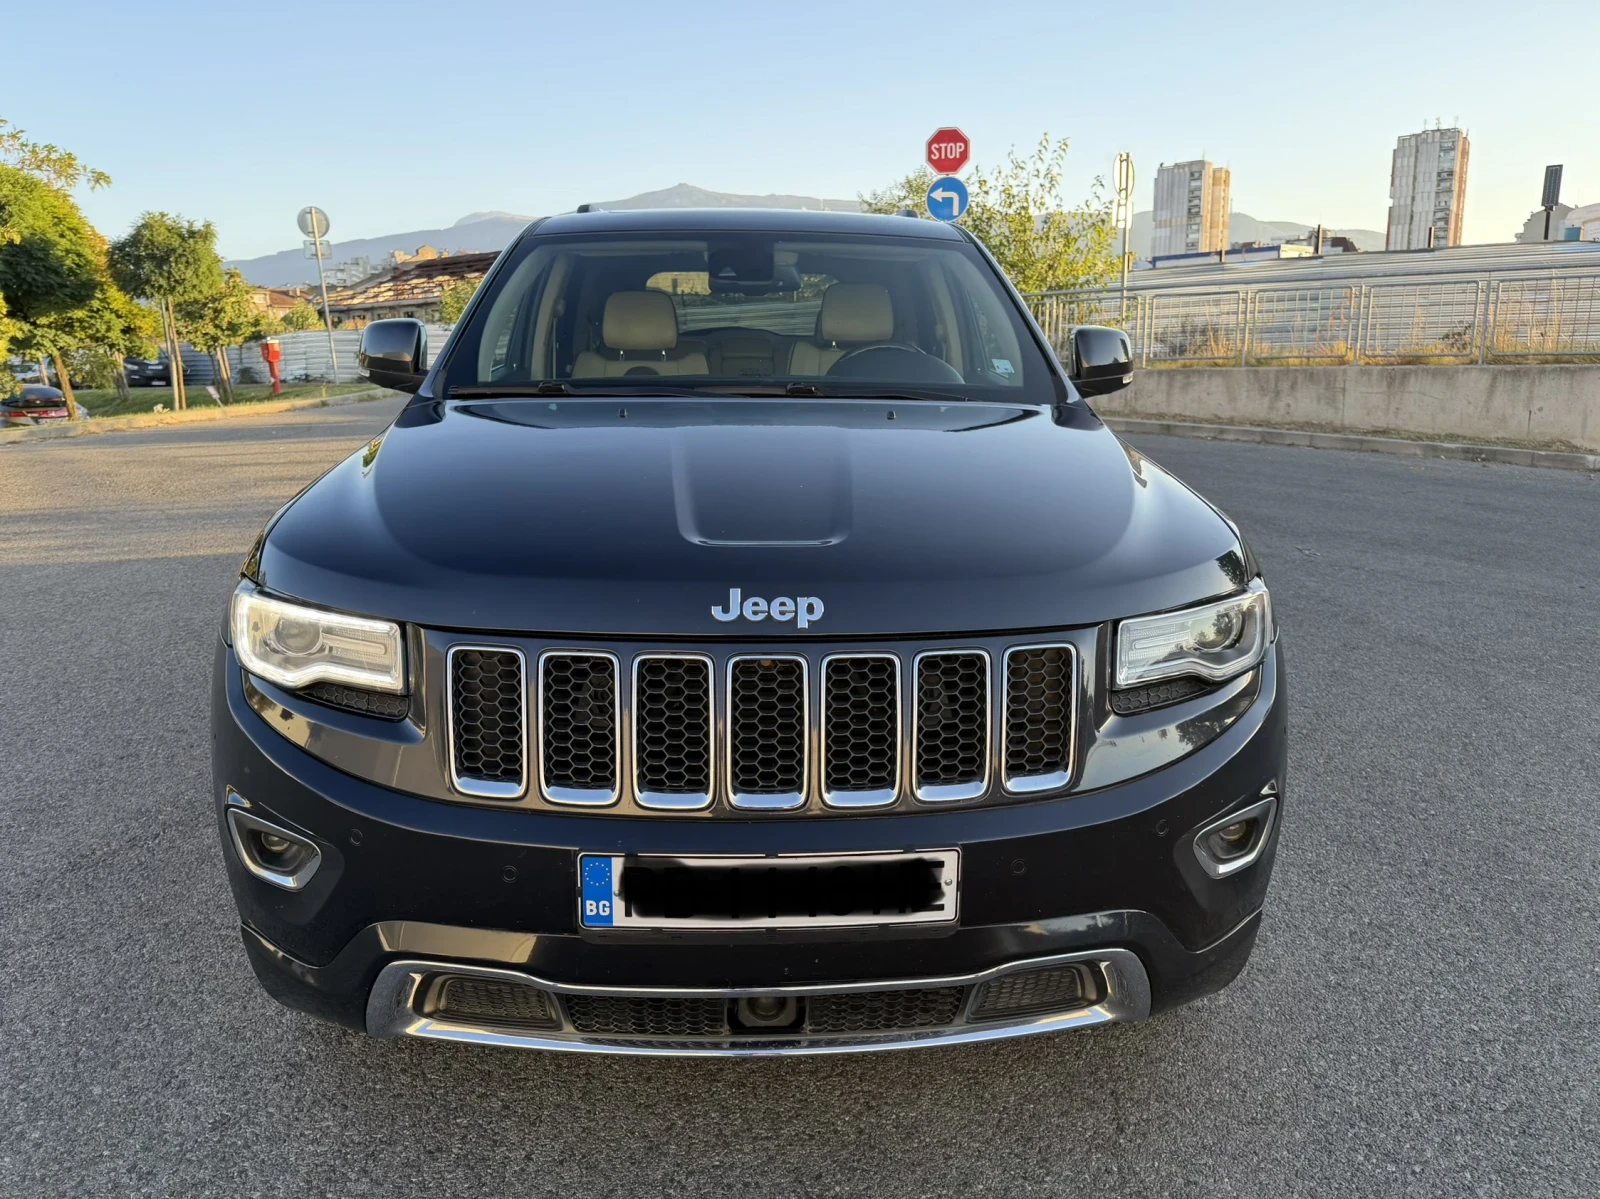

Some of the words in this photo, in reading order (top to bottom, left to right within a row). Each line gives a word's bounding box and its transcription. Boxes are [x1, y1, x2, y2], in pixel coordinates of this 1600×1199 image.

[931, 142, 965, 160] STOP
[711, 588, 825, 629] Jeep
[585, 900, 610, 916] BG
